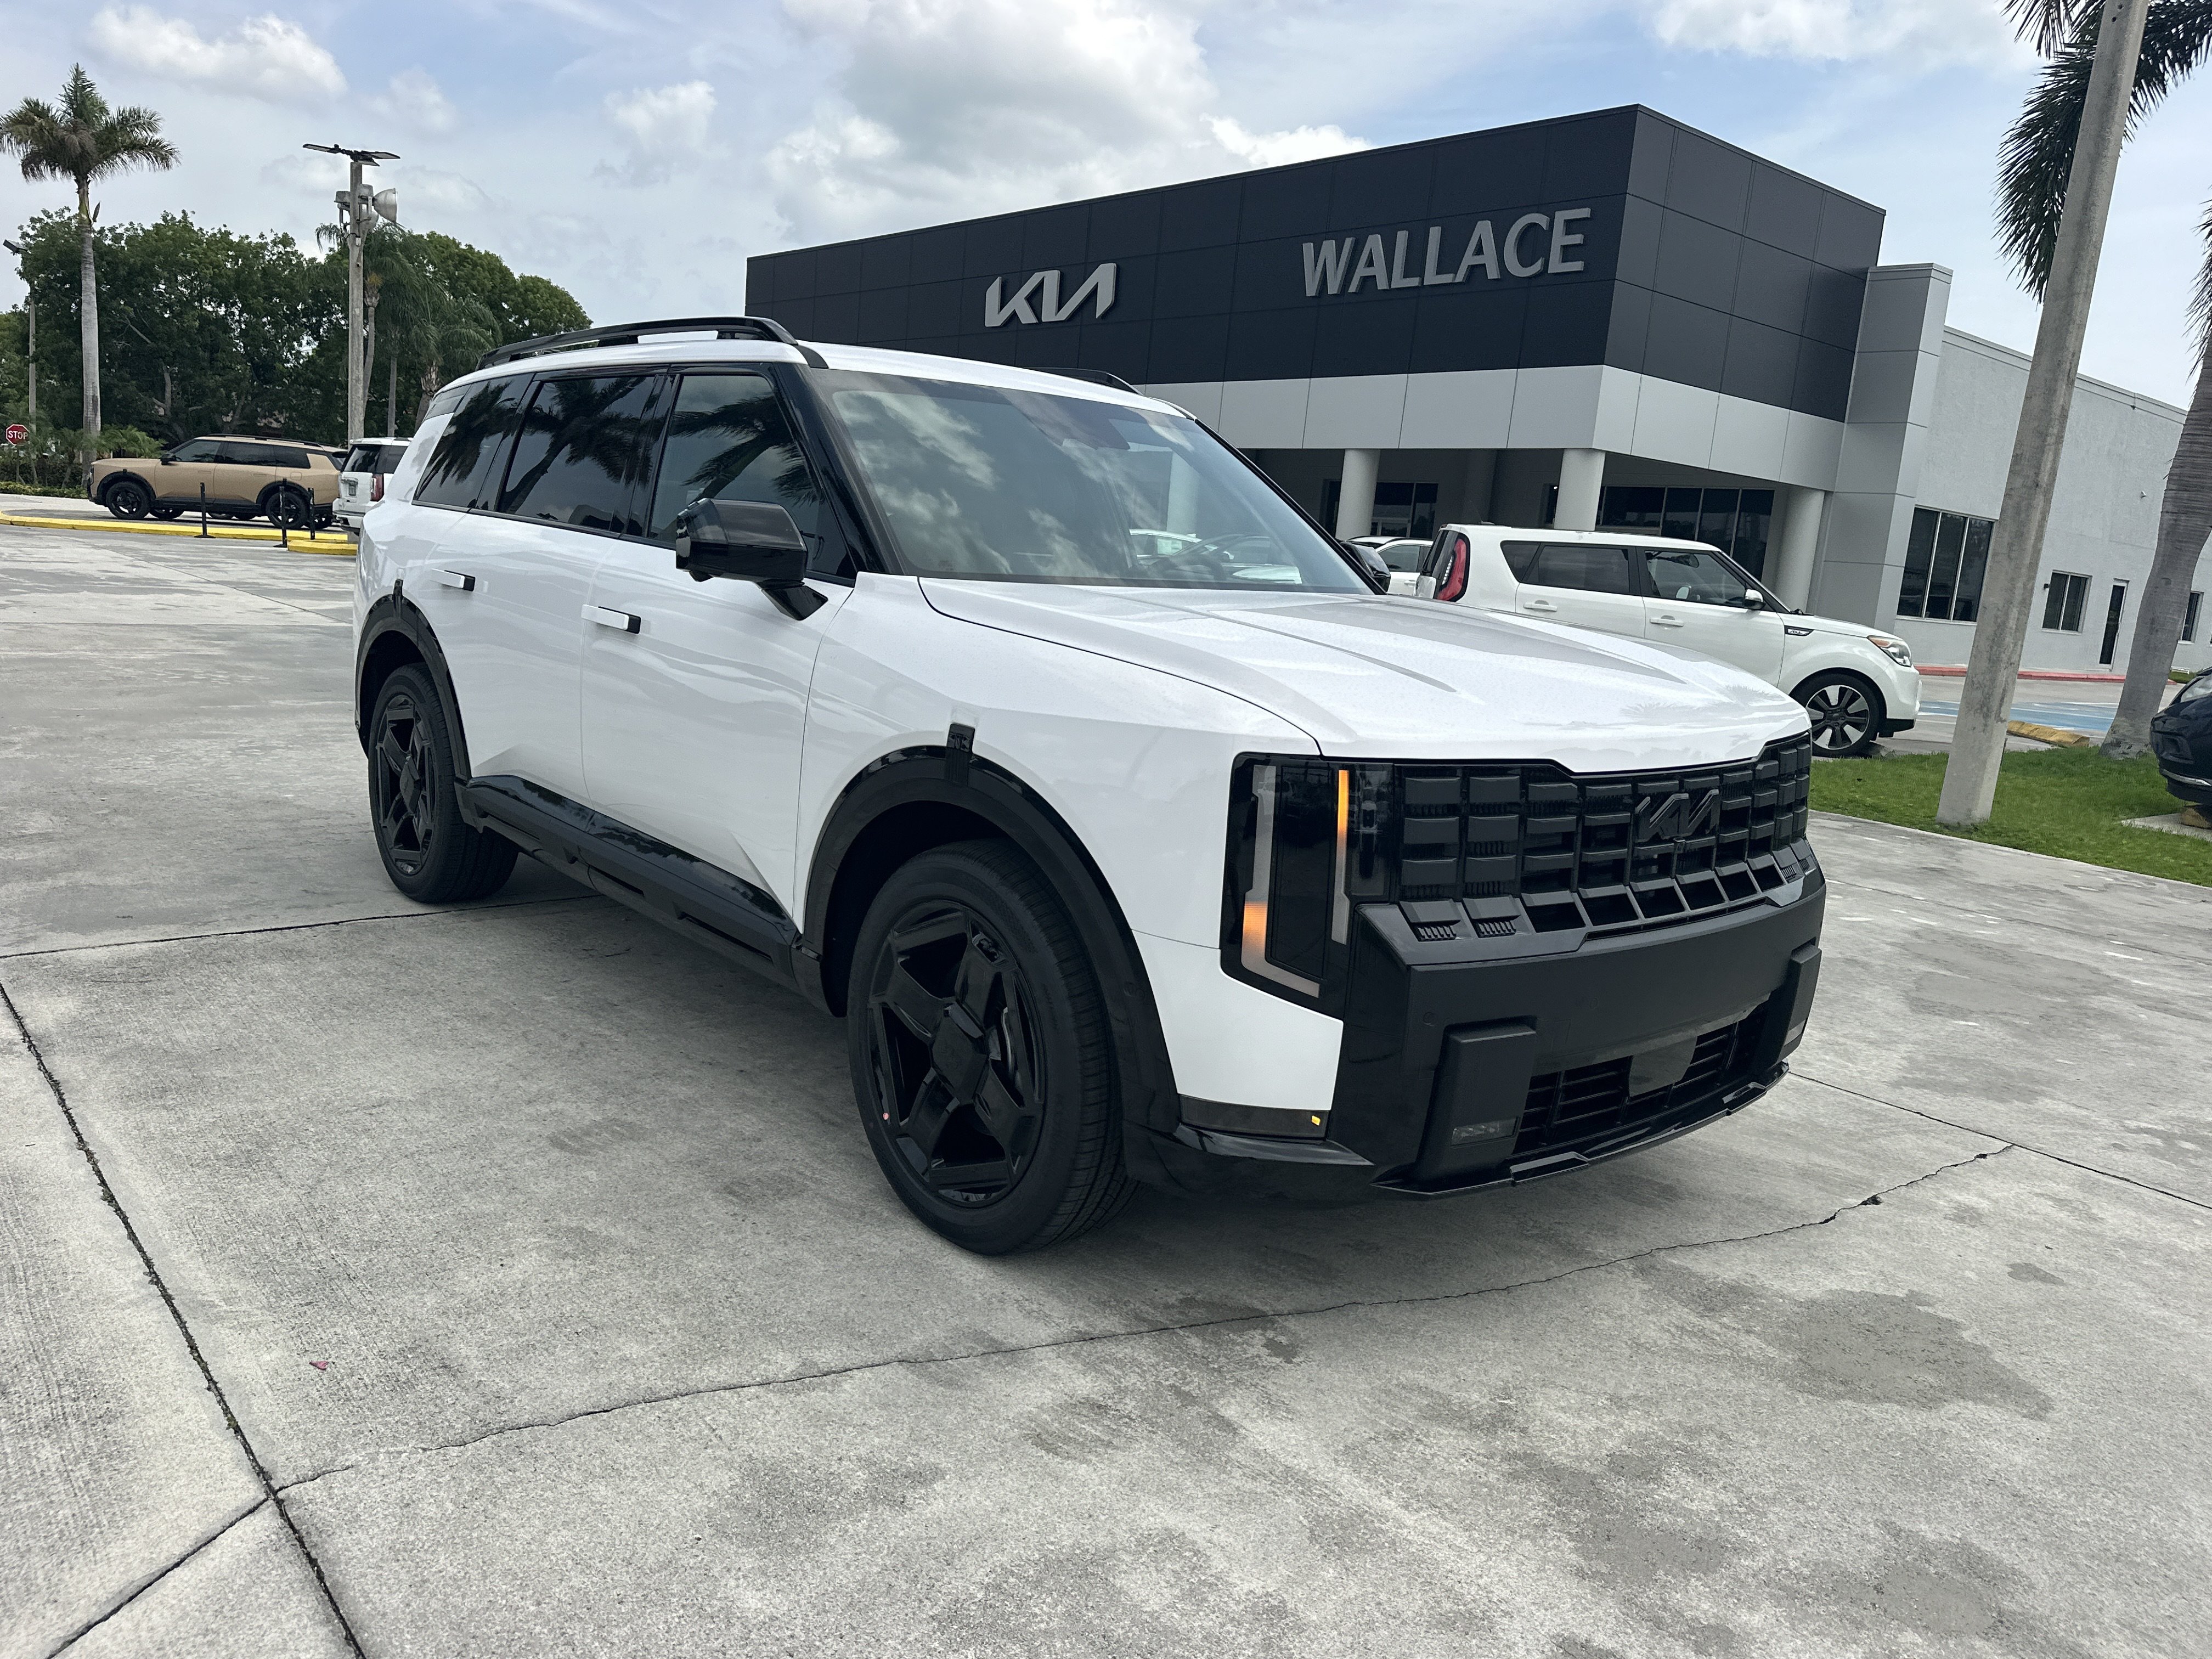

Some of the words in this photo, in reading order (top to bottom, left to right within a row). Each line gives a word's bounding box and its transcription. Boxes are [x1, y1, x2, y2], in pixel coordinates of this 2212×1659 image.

[1302, 207, 1591, 297] WALLACE
[985, 262, 1116, 327] KIA
[8, 430, 29, 439] STOP
[1634, 789, 1719, 843] KIA
